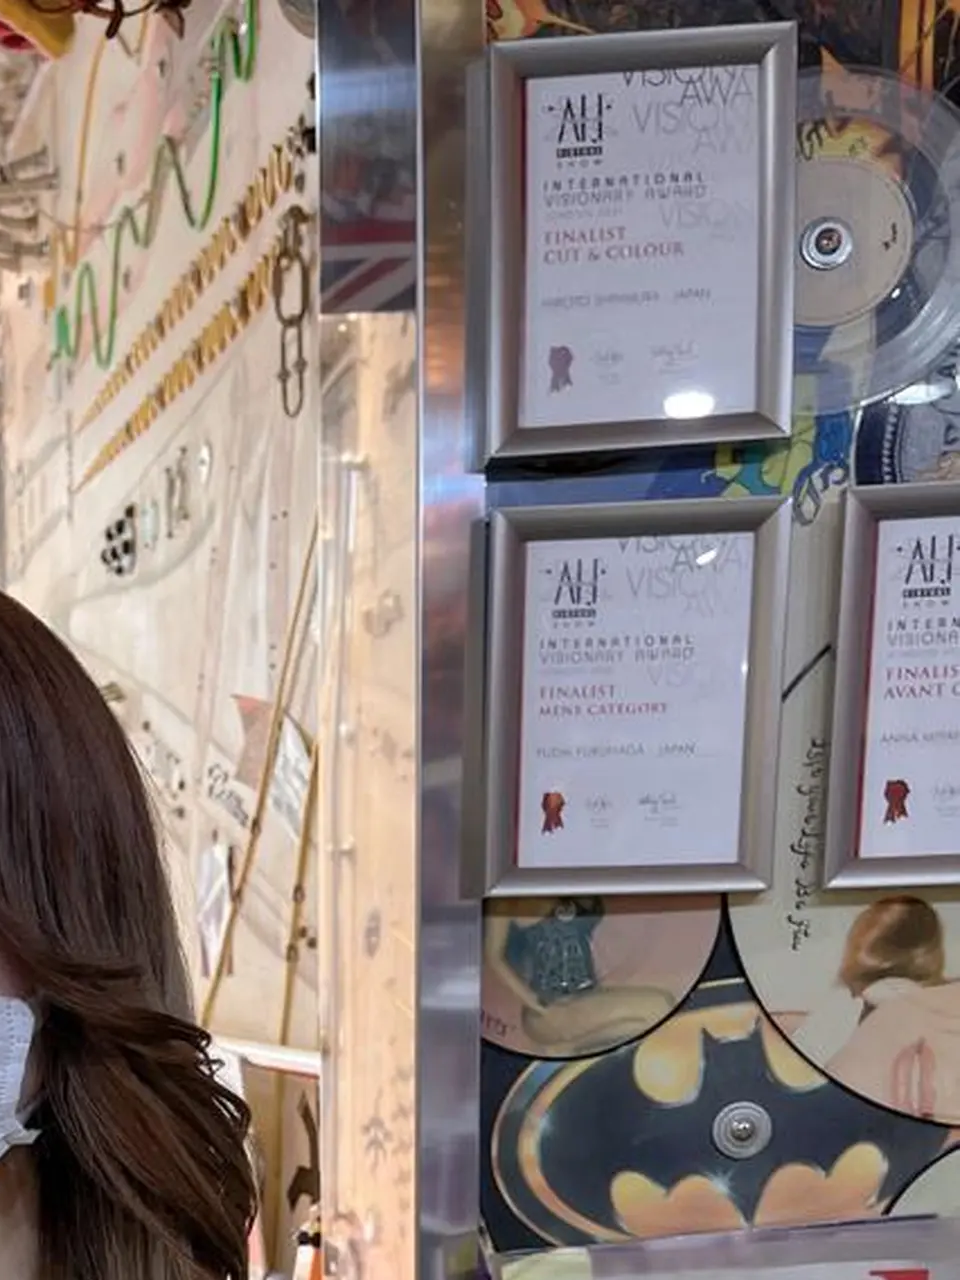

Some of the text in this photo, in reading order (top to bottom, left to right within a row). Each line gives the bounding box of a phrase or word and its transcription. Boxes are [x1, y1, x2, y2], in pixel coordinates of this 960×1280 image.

[543, 171, 706, 192] INTERNATIONAL
[543, 226, 627, 246] FINALIST
[542, 248, 582, 265] CUT
[605, 241, 685, 260] COLOUR
[540, 634, 695, 650] INTERNATIONAL
[540, 684, 615, 700] FINALIST
[883, 682, 946, 700] AVANT
